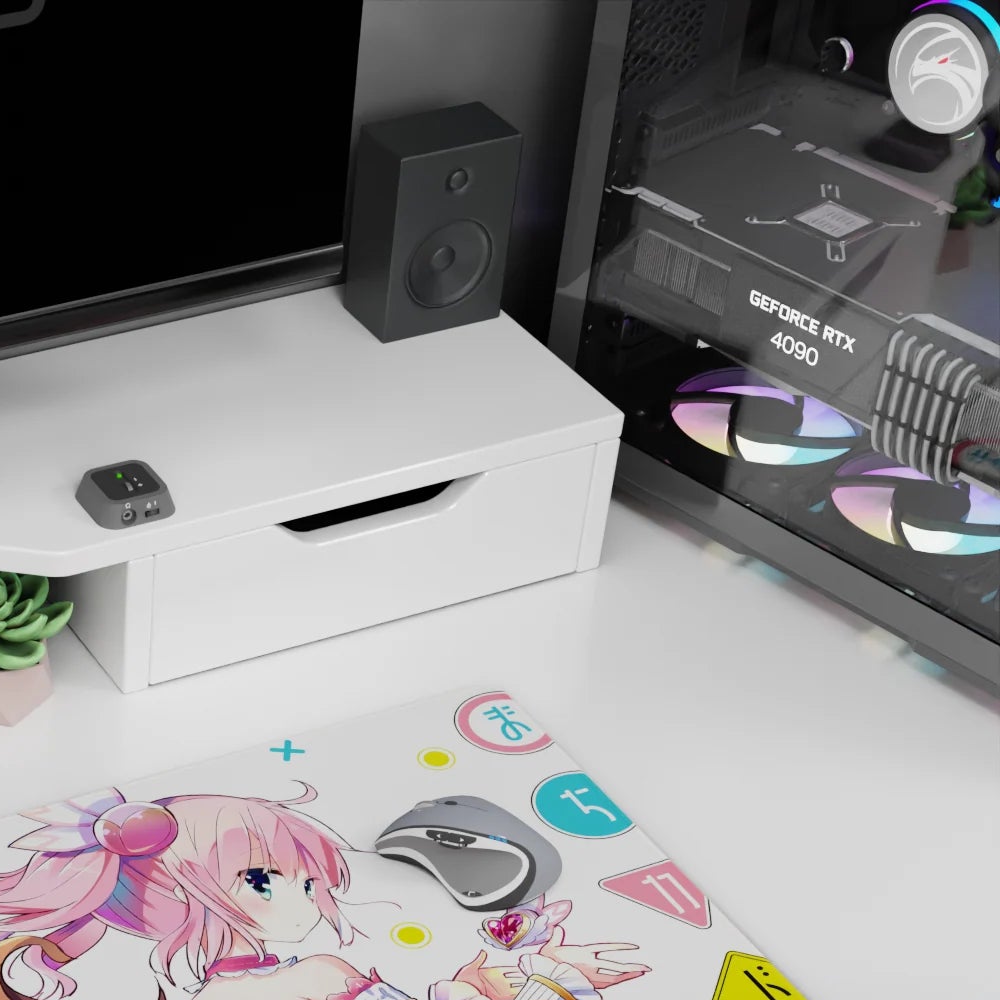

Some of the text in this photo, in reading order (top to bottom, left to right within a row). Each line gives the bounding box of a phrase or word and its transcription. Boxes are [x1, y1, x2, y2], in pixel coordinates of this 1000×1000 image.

[750, 289, 857, 354] GEFORCE RTX
[770, 331, 819, 367] 4090
